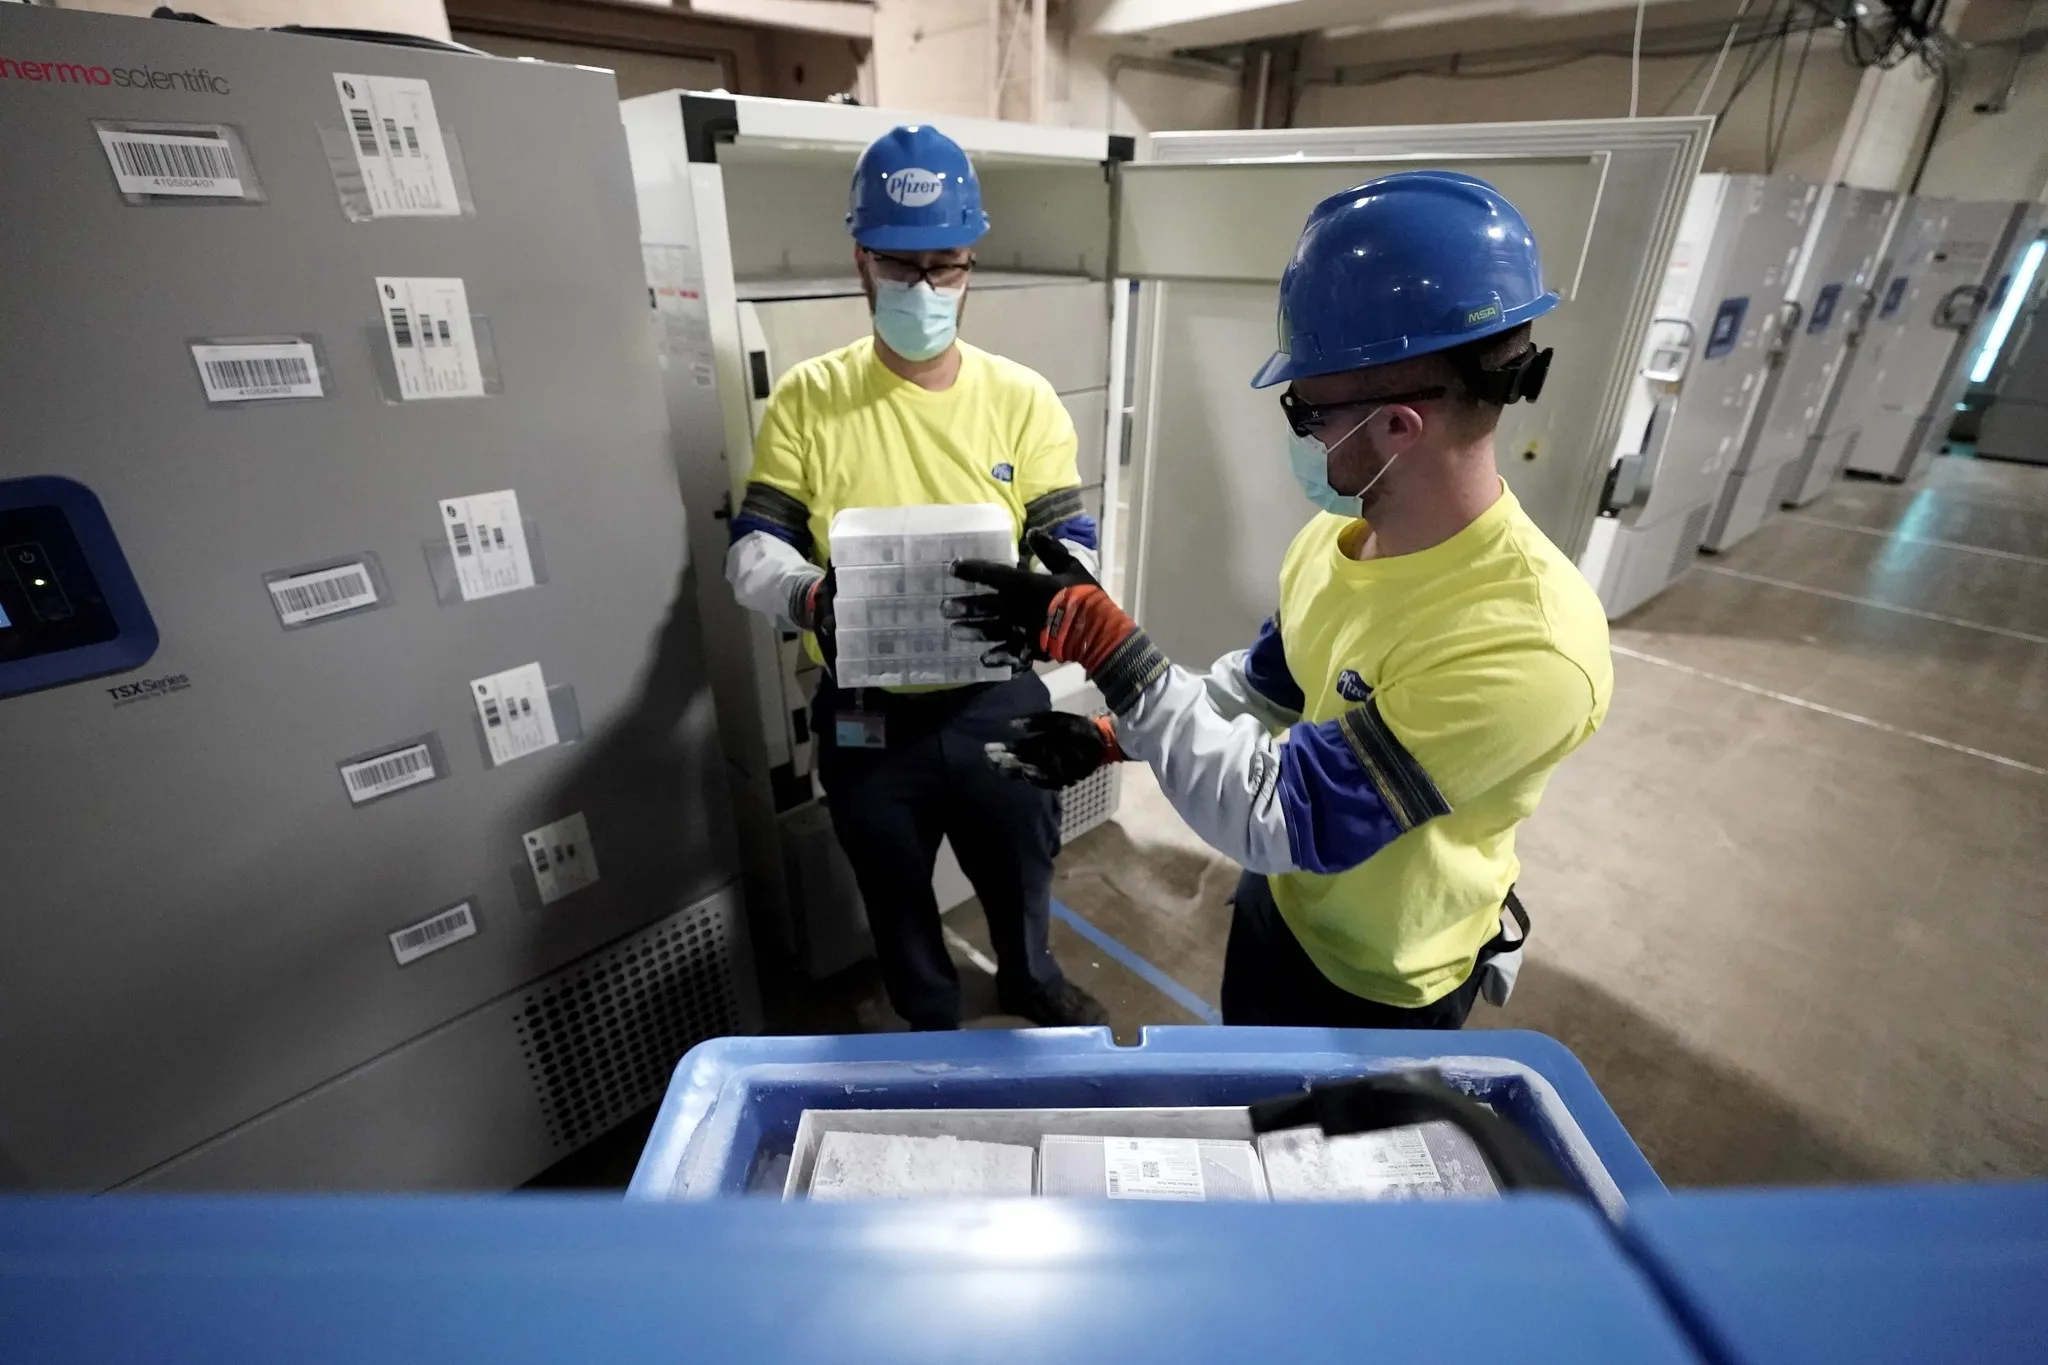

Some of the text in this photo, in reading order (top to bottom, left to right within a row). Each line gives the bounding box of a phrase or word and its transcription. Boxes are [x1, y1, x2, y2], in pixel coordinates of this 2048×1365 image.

[0, 57, 231, 95] hermo scientific
[890, 173, 940, 202] Pfizer
[1468, 307, 1496, 324] MSA
[105, 681, 144, 700] TSX
